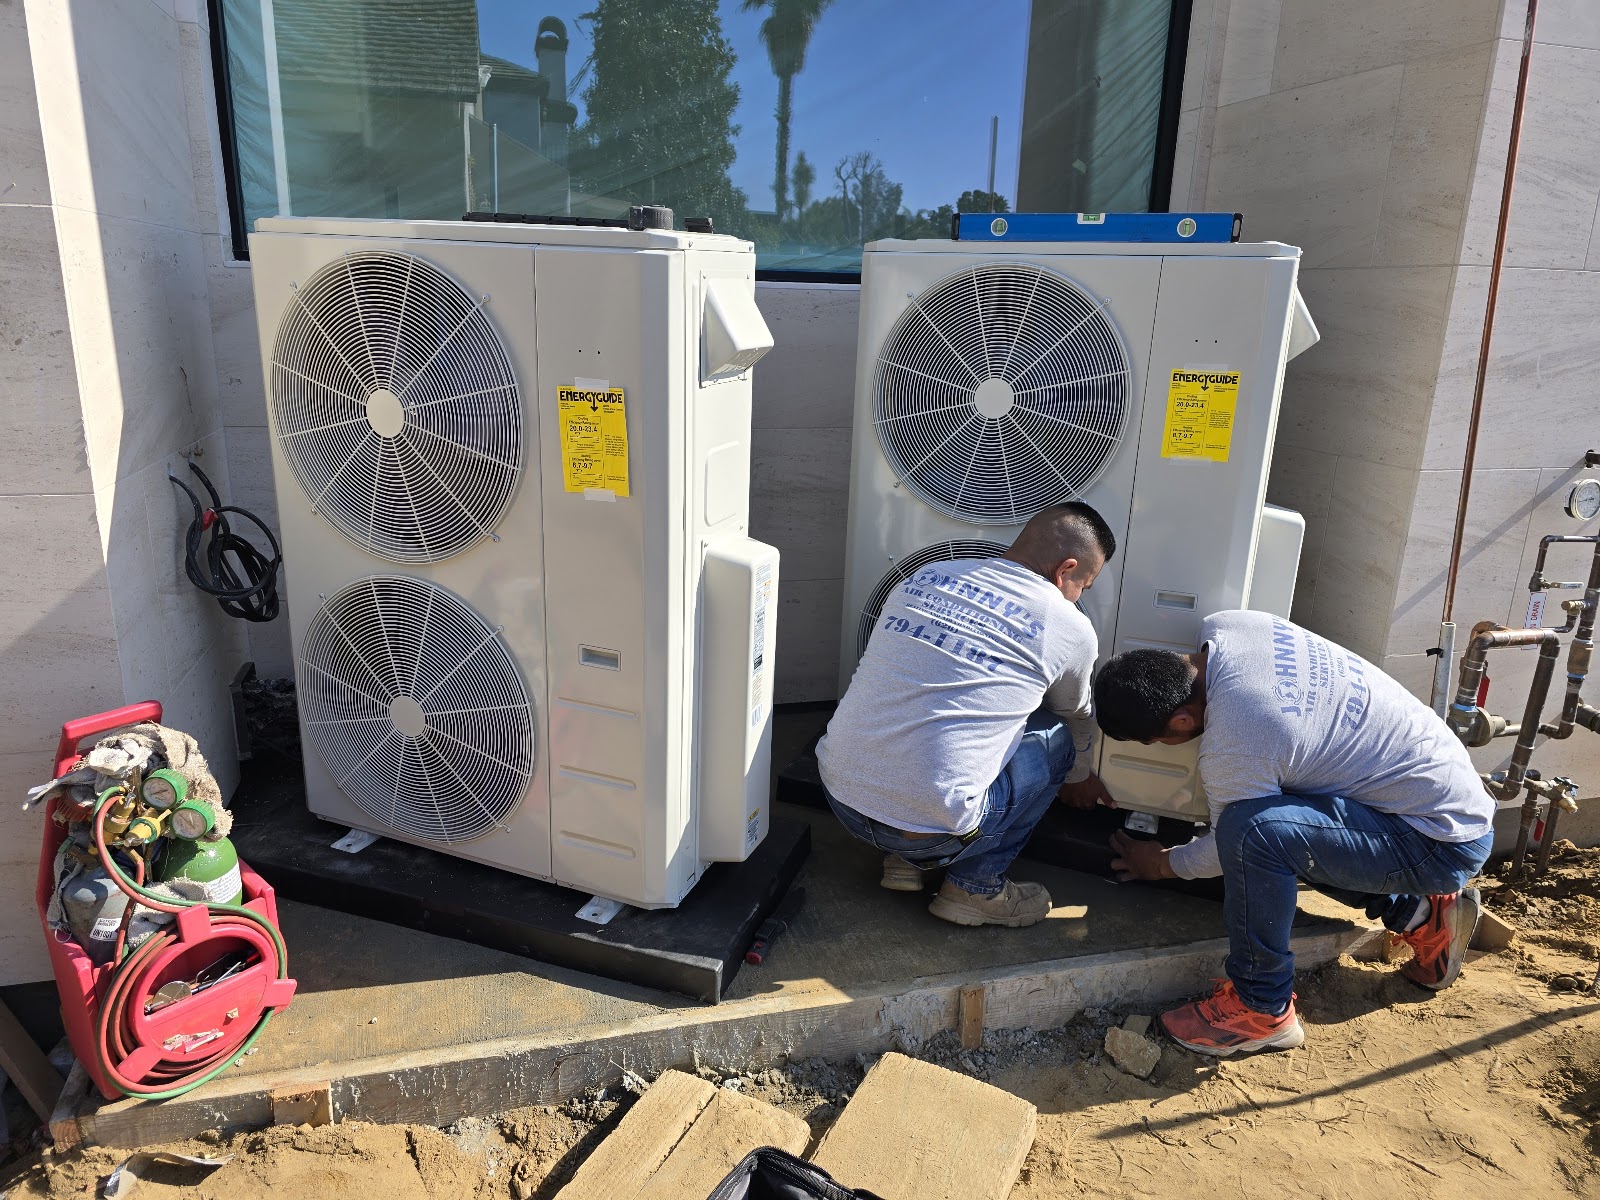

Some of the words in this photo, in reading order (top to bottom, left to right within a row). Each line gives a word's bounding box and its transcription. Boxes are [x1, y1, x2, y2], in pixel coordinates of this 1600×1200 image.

[1173, 373, 1239, 384] ENERGYGUIDE
[560, 391, 622, 403] ENERGYGUIDE
[901, 587, 922, 597] AIR
[884, 615, 1005, 672] 794-1187
[1272, 615, 1303, 717] JOHNNY
[1340, 650, 1366, 730] 794-11
[1305, 691, 1317, 717] AIR
